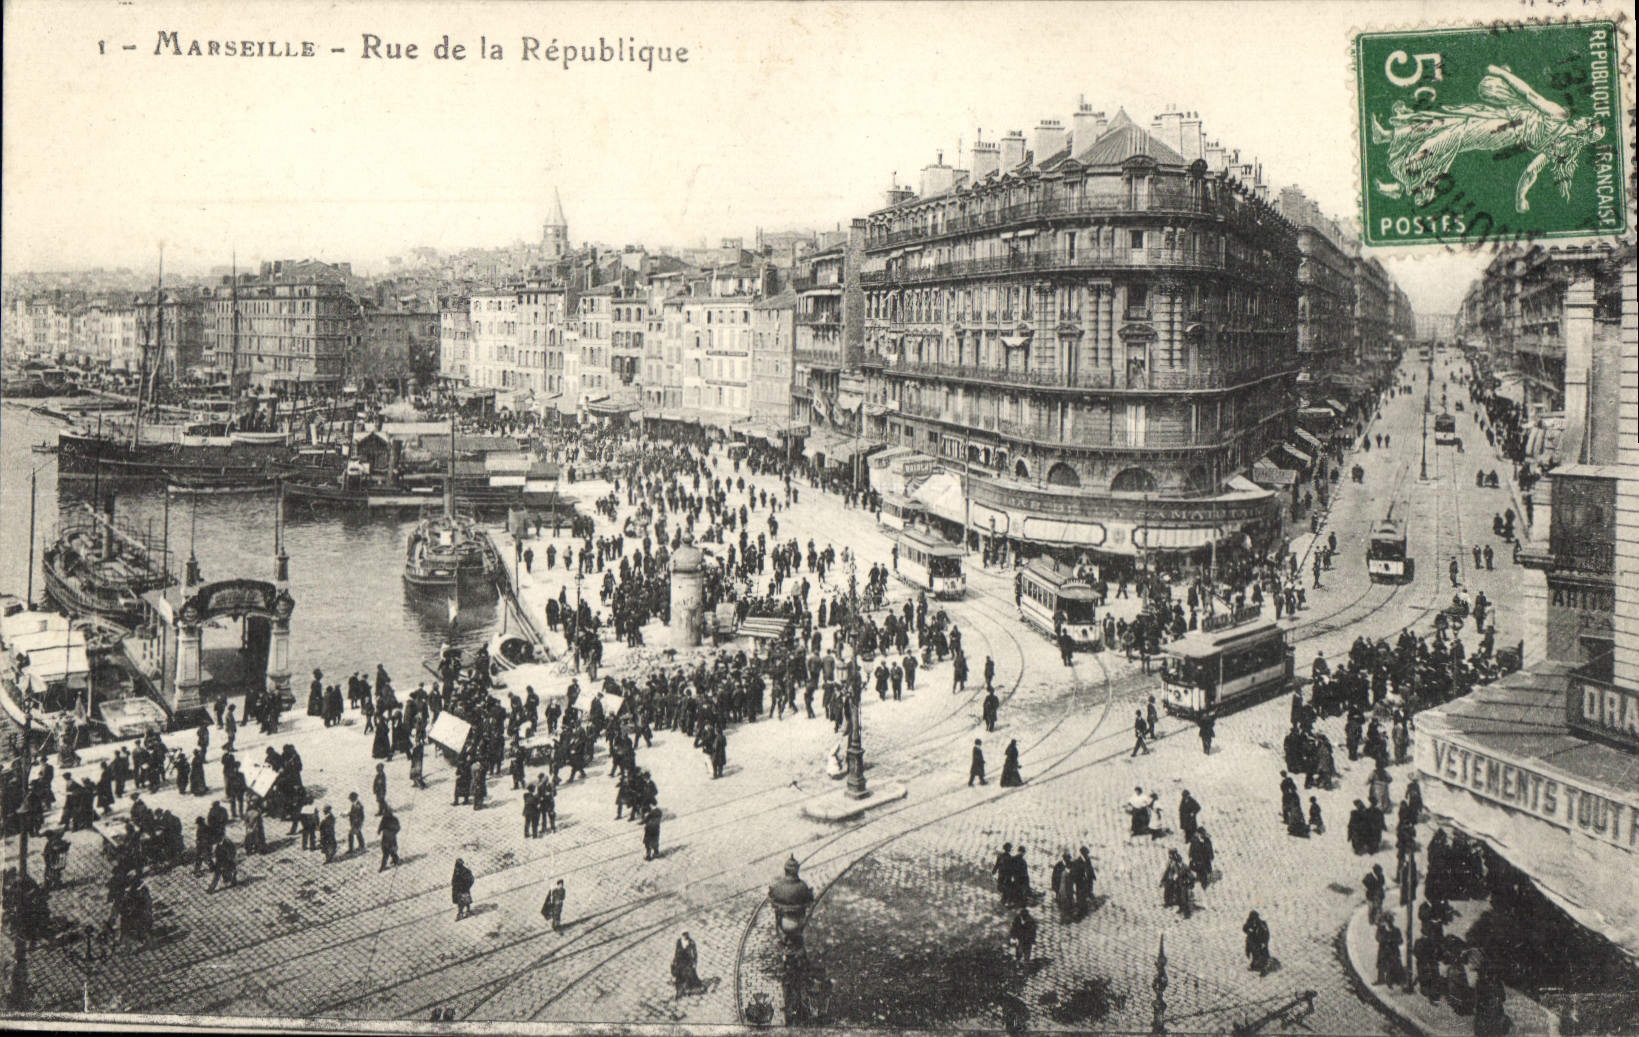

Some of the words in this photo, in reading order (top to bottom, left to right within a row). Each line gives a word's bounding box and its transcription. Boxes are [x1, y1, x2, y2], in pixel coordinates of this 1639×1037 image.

[1589, 29, 1611, 119] REPUBLIQUE
[1380, 214, 1467, 237] POSTES
[1431, 738, 1558, 817] VETEMENTS
[1565, 785, 1623, 841] TOUT
